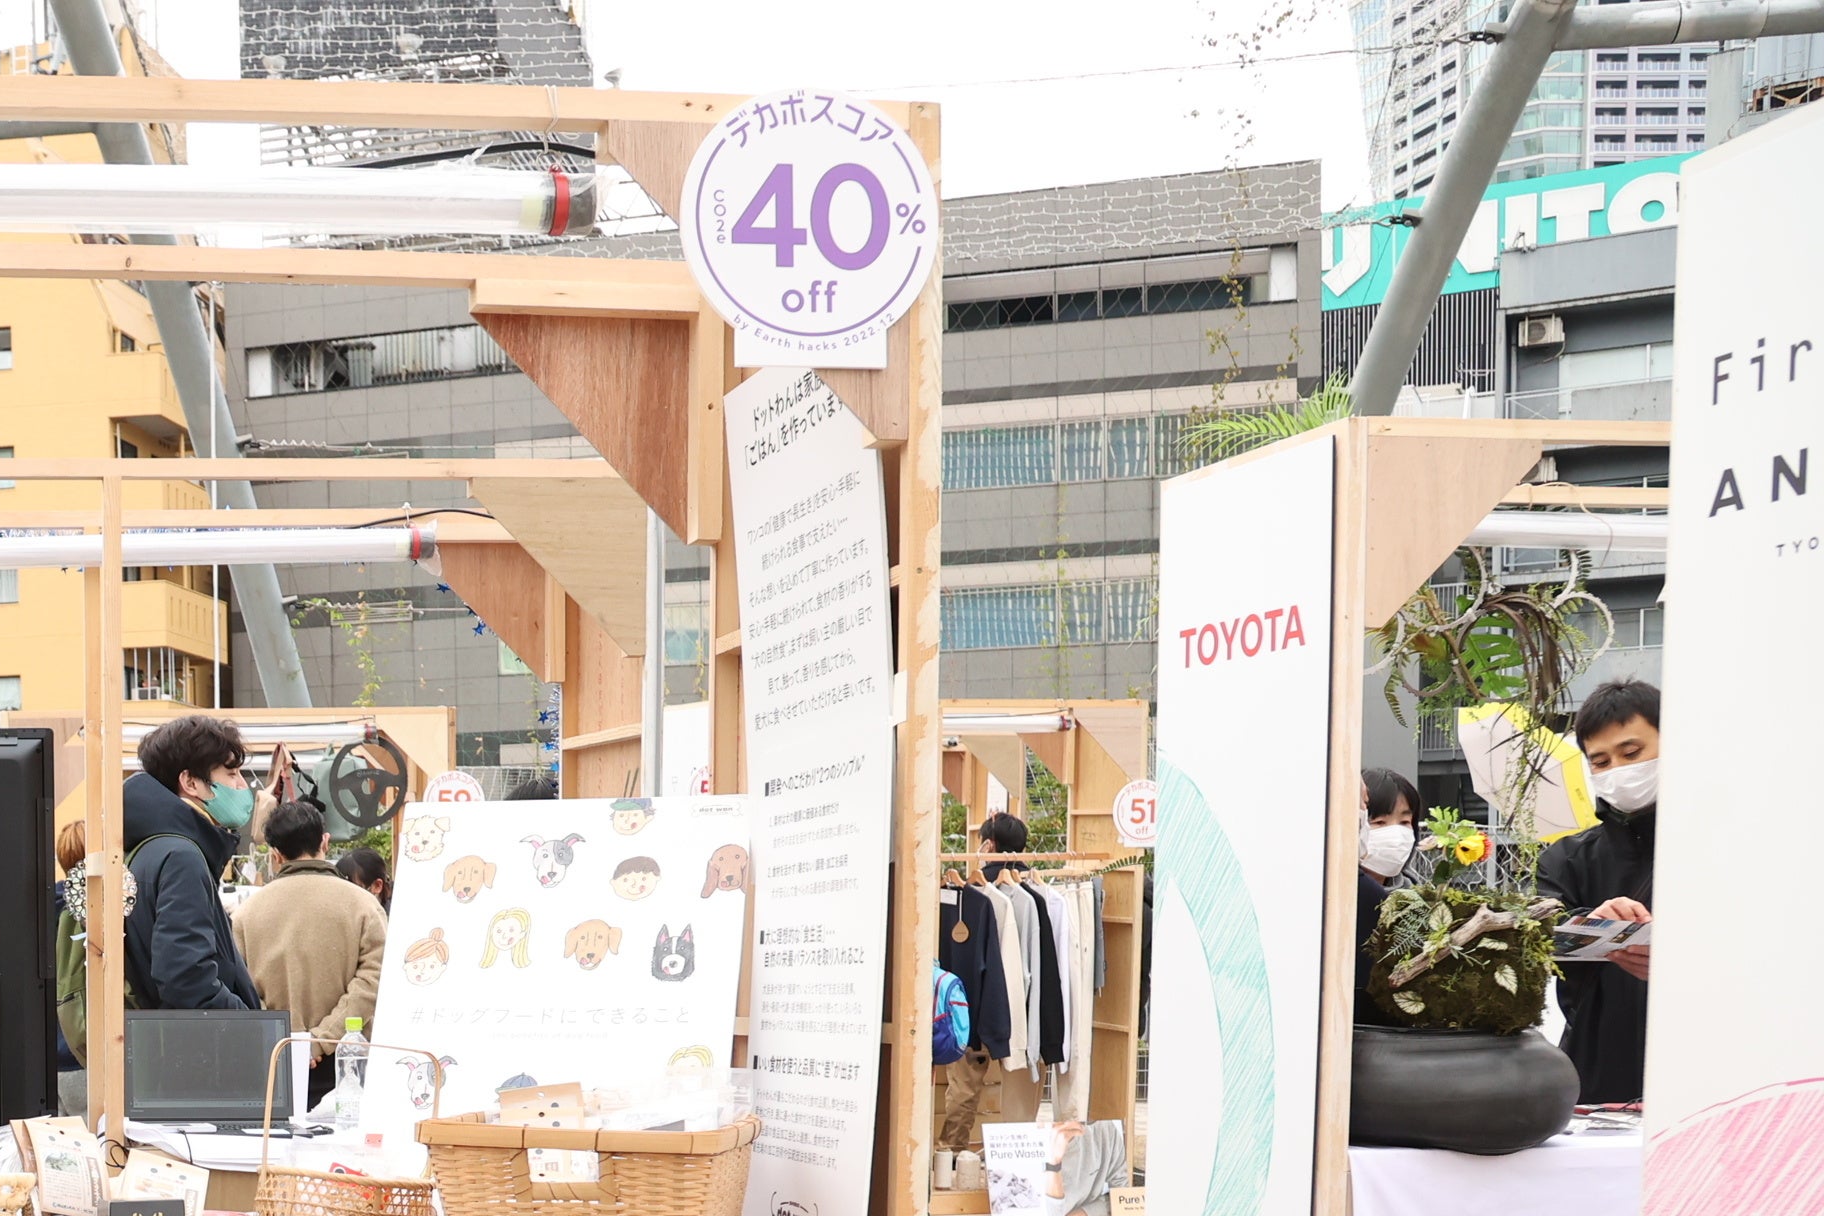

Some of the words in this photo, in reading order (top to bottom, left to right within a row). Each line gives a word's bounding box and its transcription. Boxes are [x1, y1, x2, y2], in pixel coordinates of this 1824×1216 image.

[726, 90, 894, 148] デカボスコア
[713, 189, 726, 244] CO2e
[731, 163, 891, 271] 40
[895, 203, 926, 235] %
[782, 280, 838, 313] off
[733, 313, 749, 331] by
[754, 327, 791, 348] Earth
[798, 340, 837, 351] hacks
[844, 313, 895, 347] 2022.12
[1712, 337, 1813, 406] Fir
[1709, 447, 1808, 518] AN
[1776, 536, 1819, 557] TYO
[1179, 605, 1306, 669] TOYOTA
[1130, 798, 1155, 824] 51
[764, 947, 864, 968] 自然の栄養バランスを取り入れること
[990, 1150, 1013, 1159] Pure
[1015, 1149, 1046, 1159] Waste
